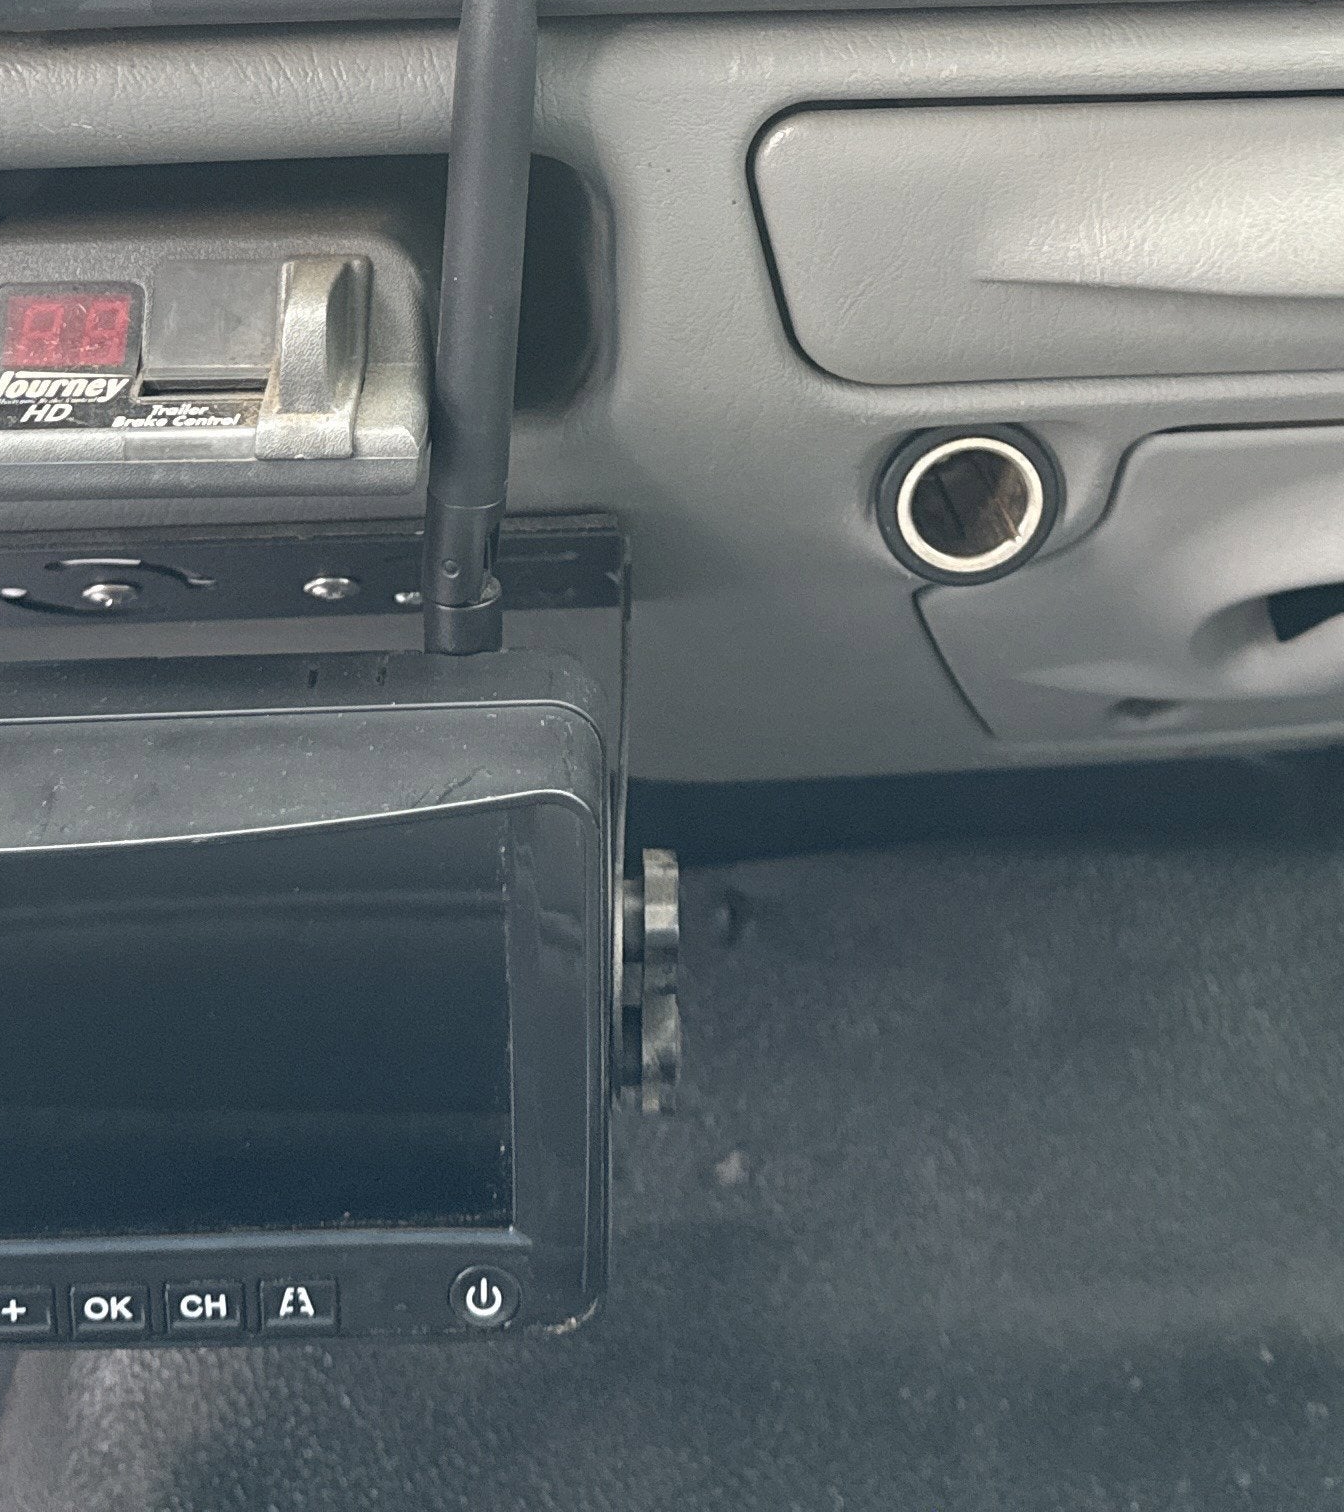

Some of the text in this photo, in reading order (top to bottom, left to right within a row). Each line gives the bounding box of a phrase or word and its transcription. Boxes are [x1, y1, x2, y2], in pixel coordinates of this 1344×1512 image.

[19, 403, 74, 423] HD
[150, 403, 209, 416] Trailer
[111, 412, 242, 428] Brake Control
[84, 1296, 133, 1321] OK
[180, 1294, 227, 1319] CH
